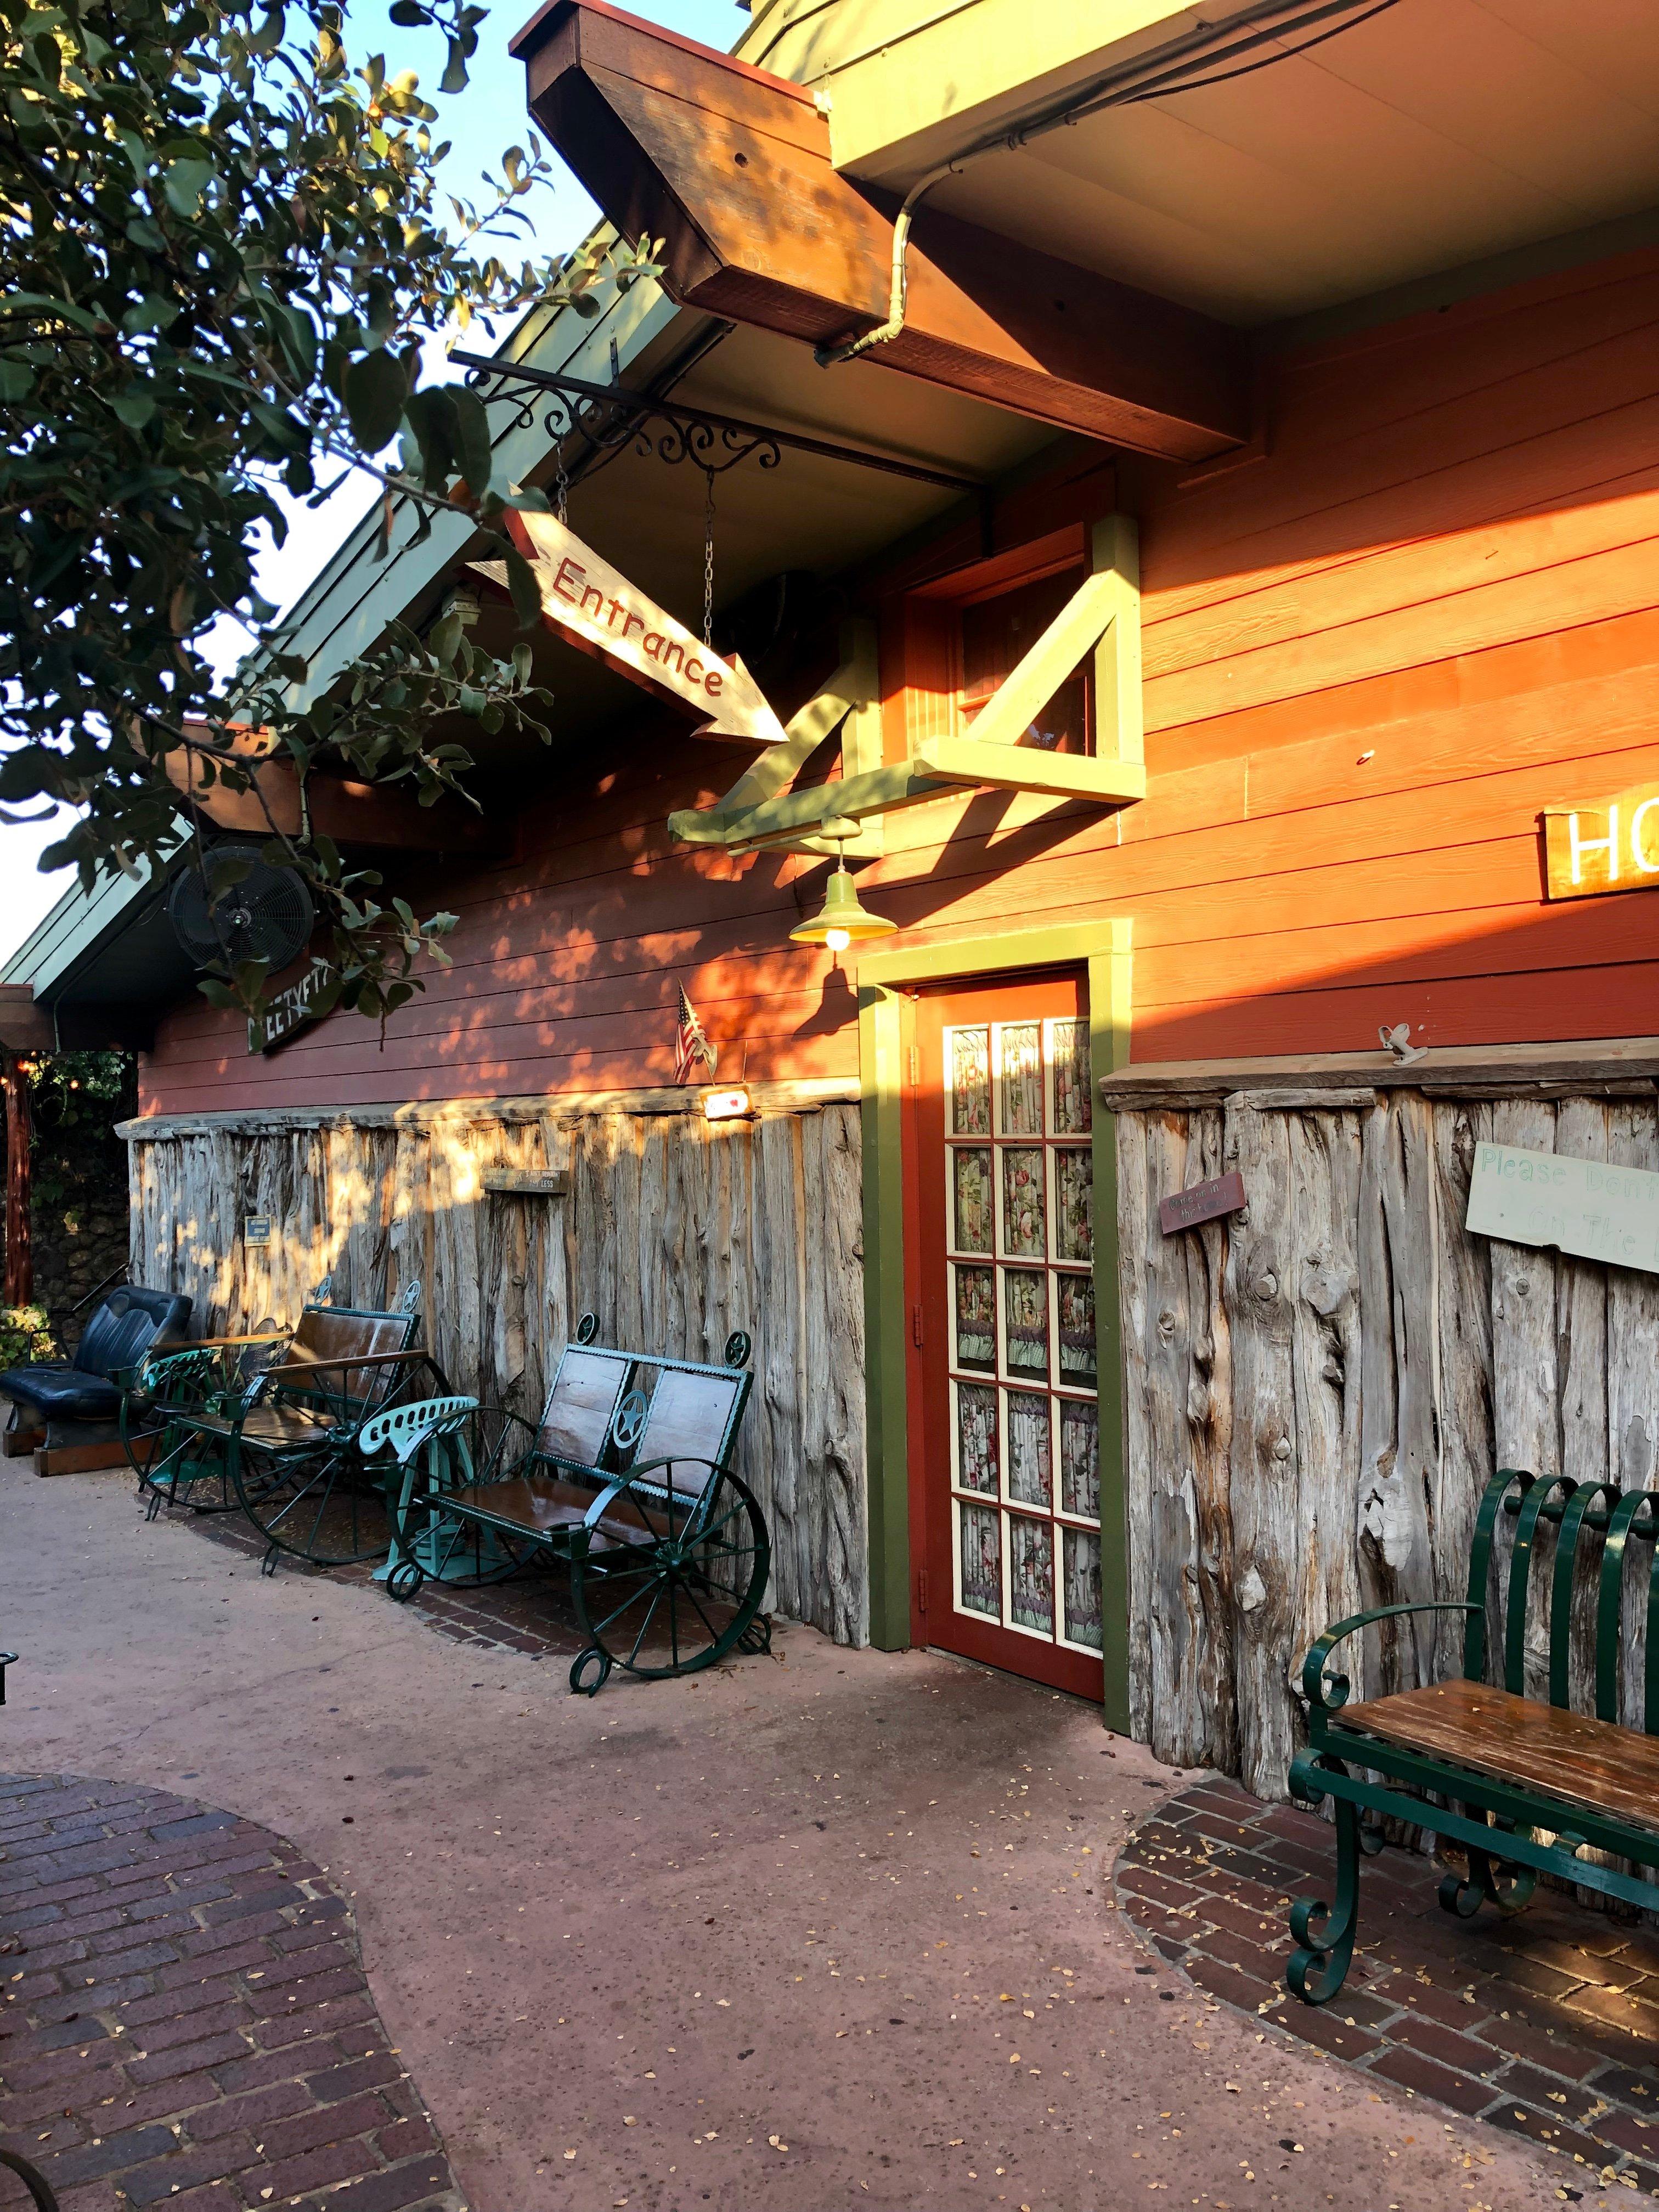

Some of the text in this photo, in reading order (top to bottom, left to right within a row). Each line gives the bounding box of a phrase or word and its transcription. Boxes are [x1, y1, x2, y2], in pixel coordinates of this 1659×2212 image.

[552, 557, 723, 697] Entrance
[540, 1180, 554, 1188] LESS
[1481, 1148, 1567, 1186] Please
[1528, 1205, 1565, 1236] On
[1583, 1214, 1635, 1255] The
